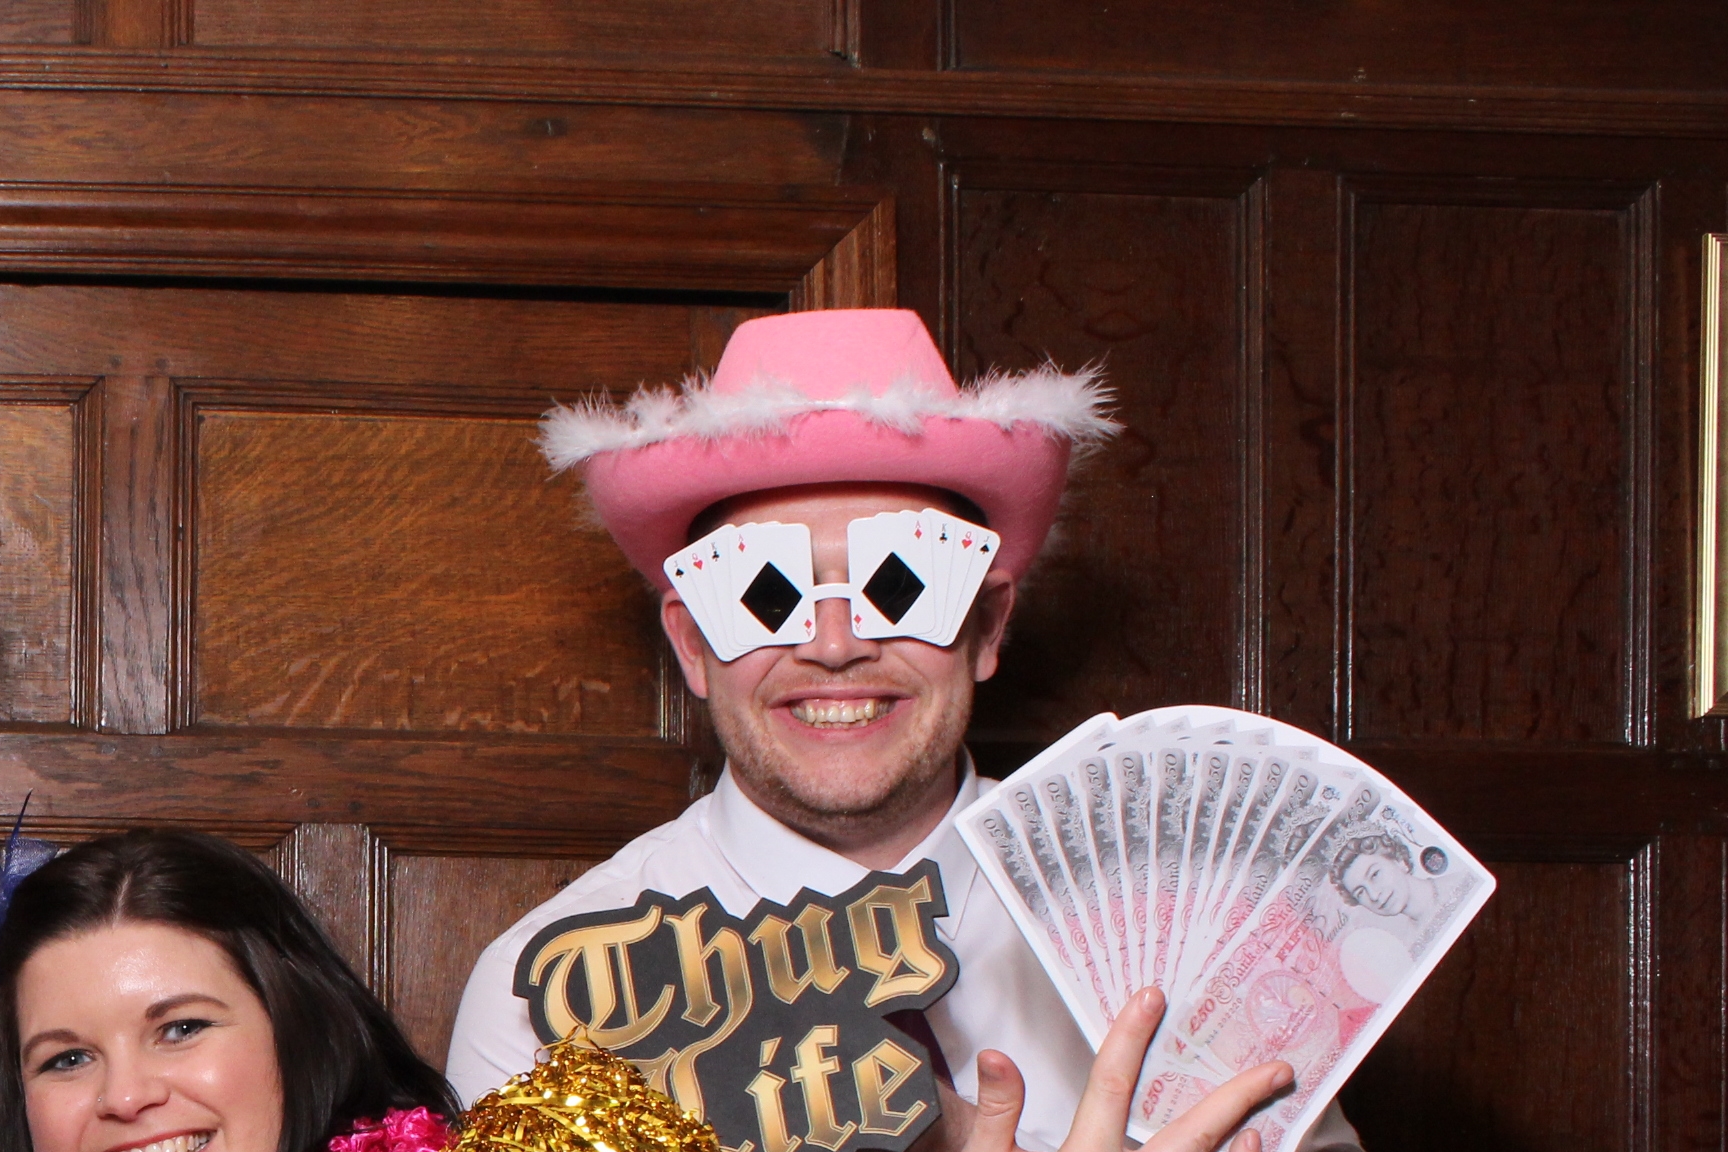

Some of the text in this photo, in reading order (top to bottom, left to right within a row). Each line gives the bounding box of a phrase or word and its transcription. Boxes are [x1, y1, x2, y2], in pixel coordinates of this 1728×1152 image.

[1276, 908, 1317, 962] FIFTY
[529, 875, 946, 1054] Thug
[1190, 998, 1215, 1036] £50
[1142, 1079, 1164, 1121] £50
